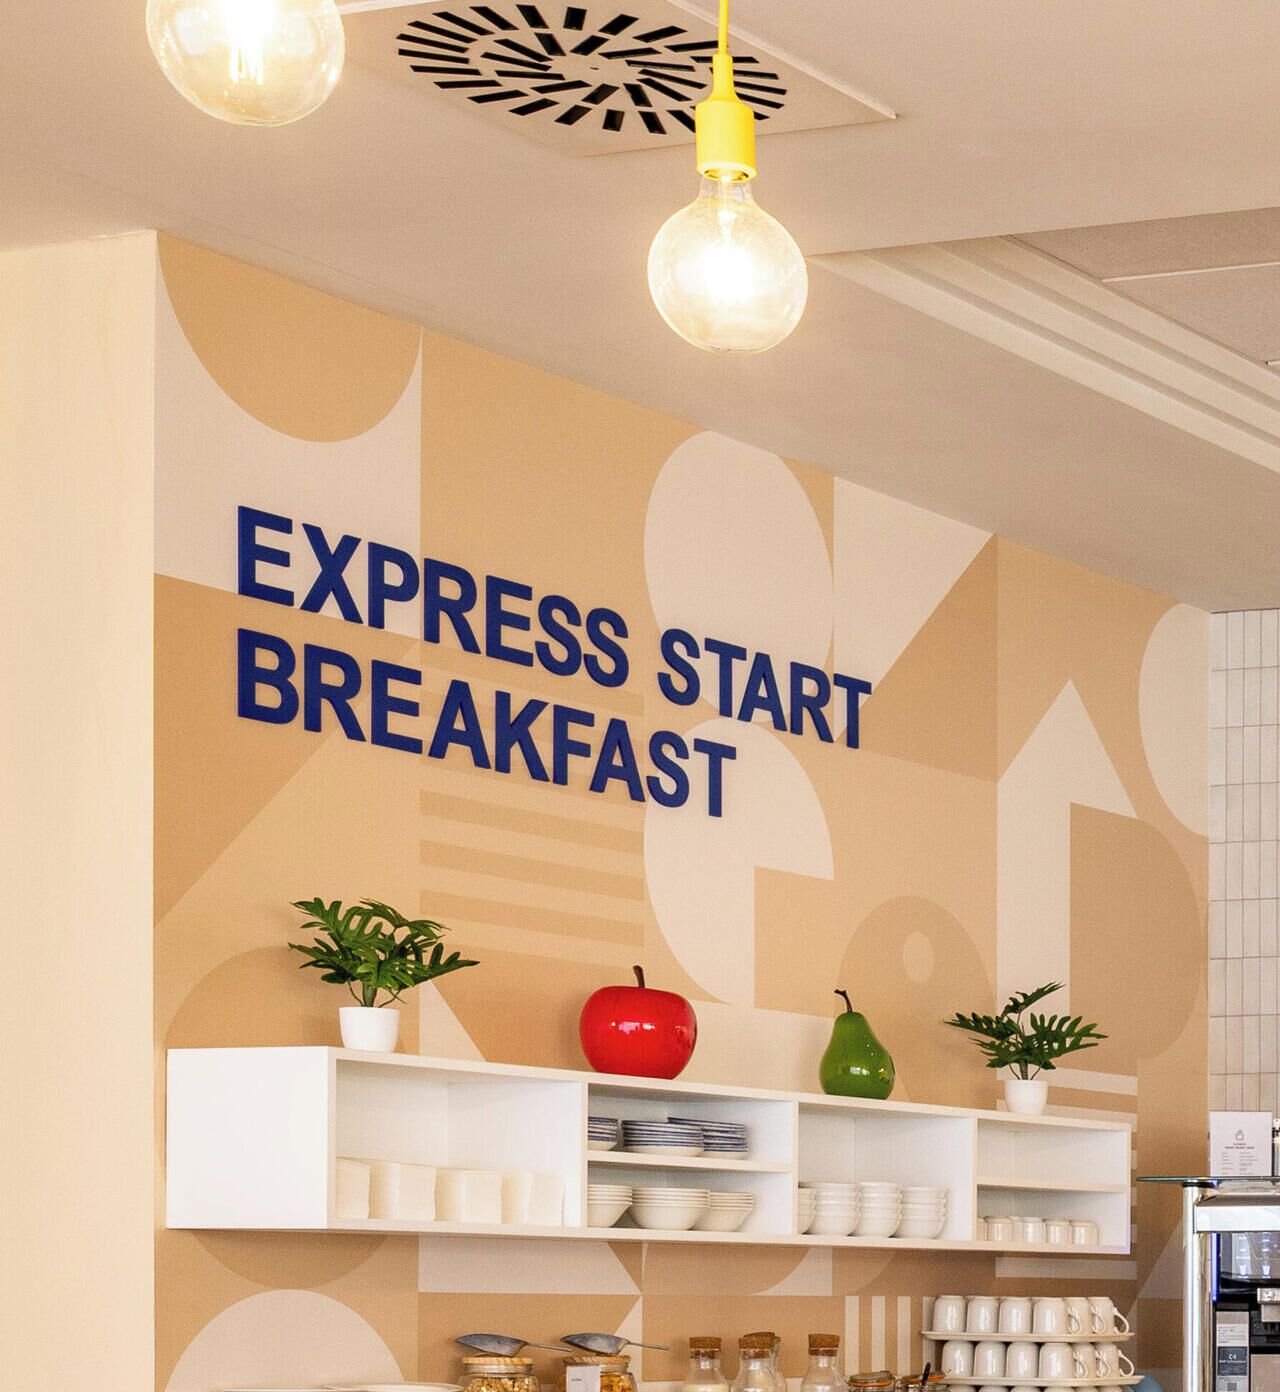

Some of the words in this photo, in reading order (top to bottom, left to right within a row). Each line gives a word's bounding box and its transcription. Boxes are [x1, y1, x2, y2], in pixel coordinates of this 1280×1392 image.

[237, 504, 629, 688] EXPRESS
[657, 628, 873, 750] START
[237, 628, 737, 818] BREAKFAST
